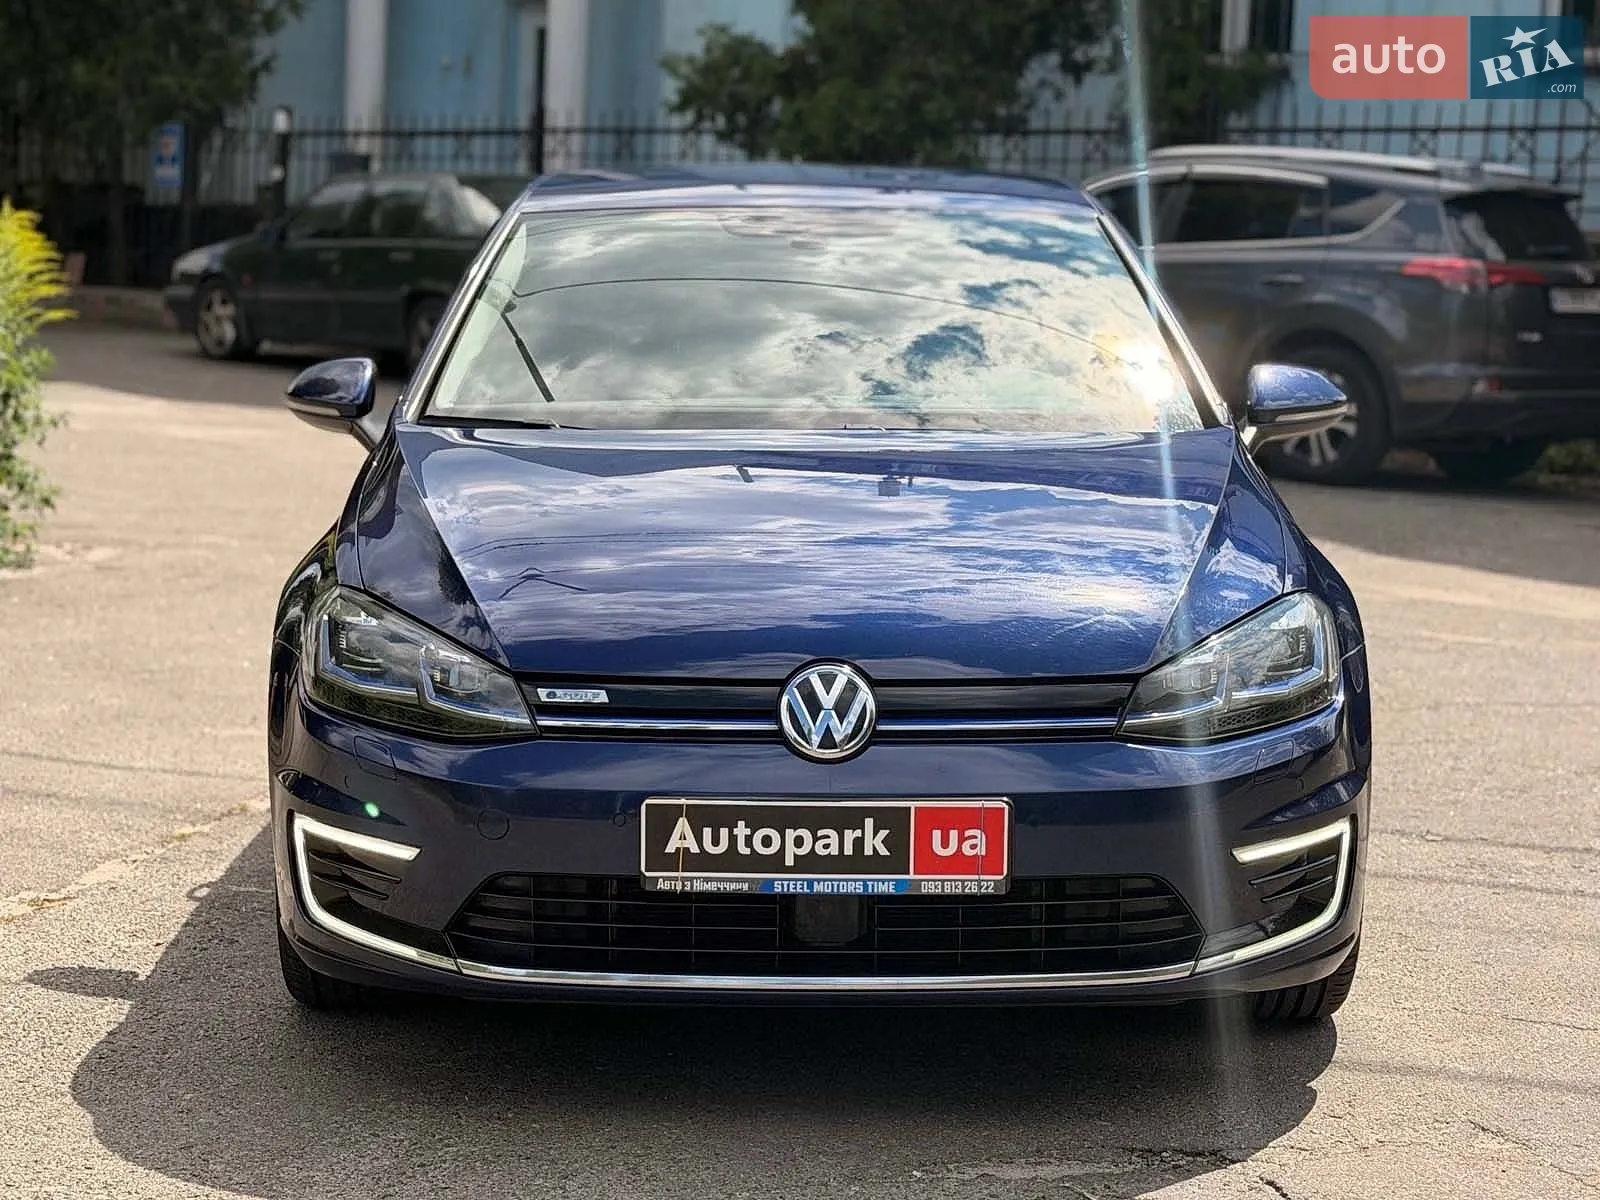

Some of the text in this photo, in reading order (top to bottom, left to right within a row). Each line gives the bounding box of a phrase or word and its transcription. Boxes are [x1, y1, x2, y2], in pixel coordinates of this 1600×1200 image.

[664, 816, 987, 866] Autopark ua
[656, 878, 682, 891] Авто
[773, 881, 896, 893] STEEL MOTORS TIME
[921, 881, 994, 893] 093 813 26 22
